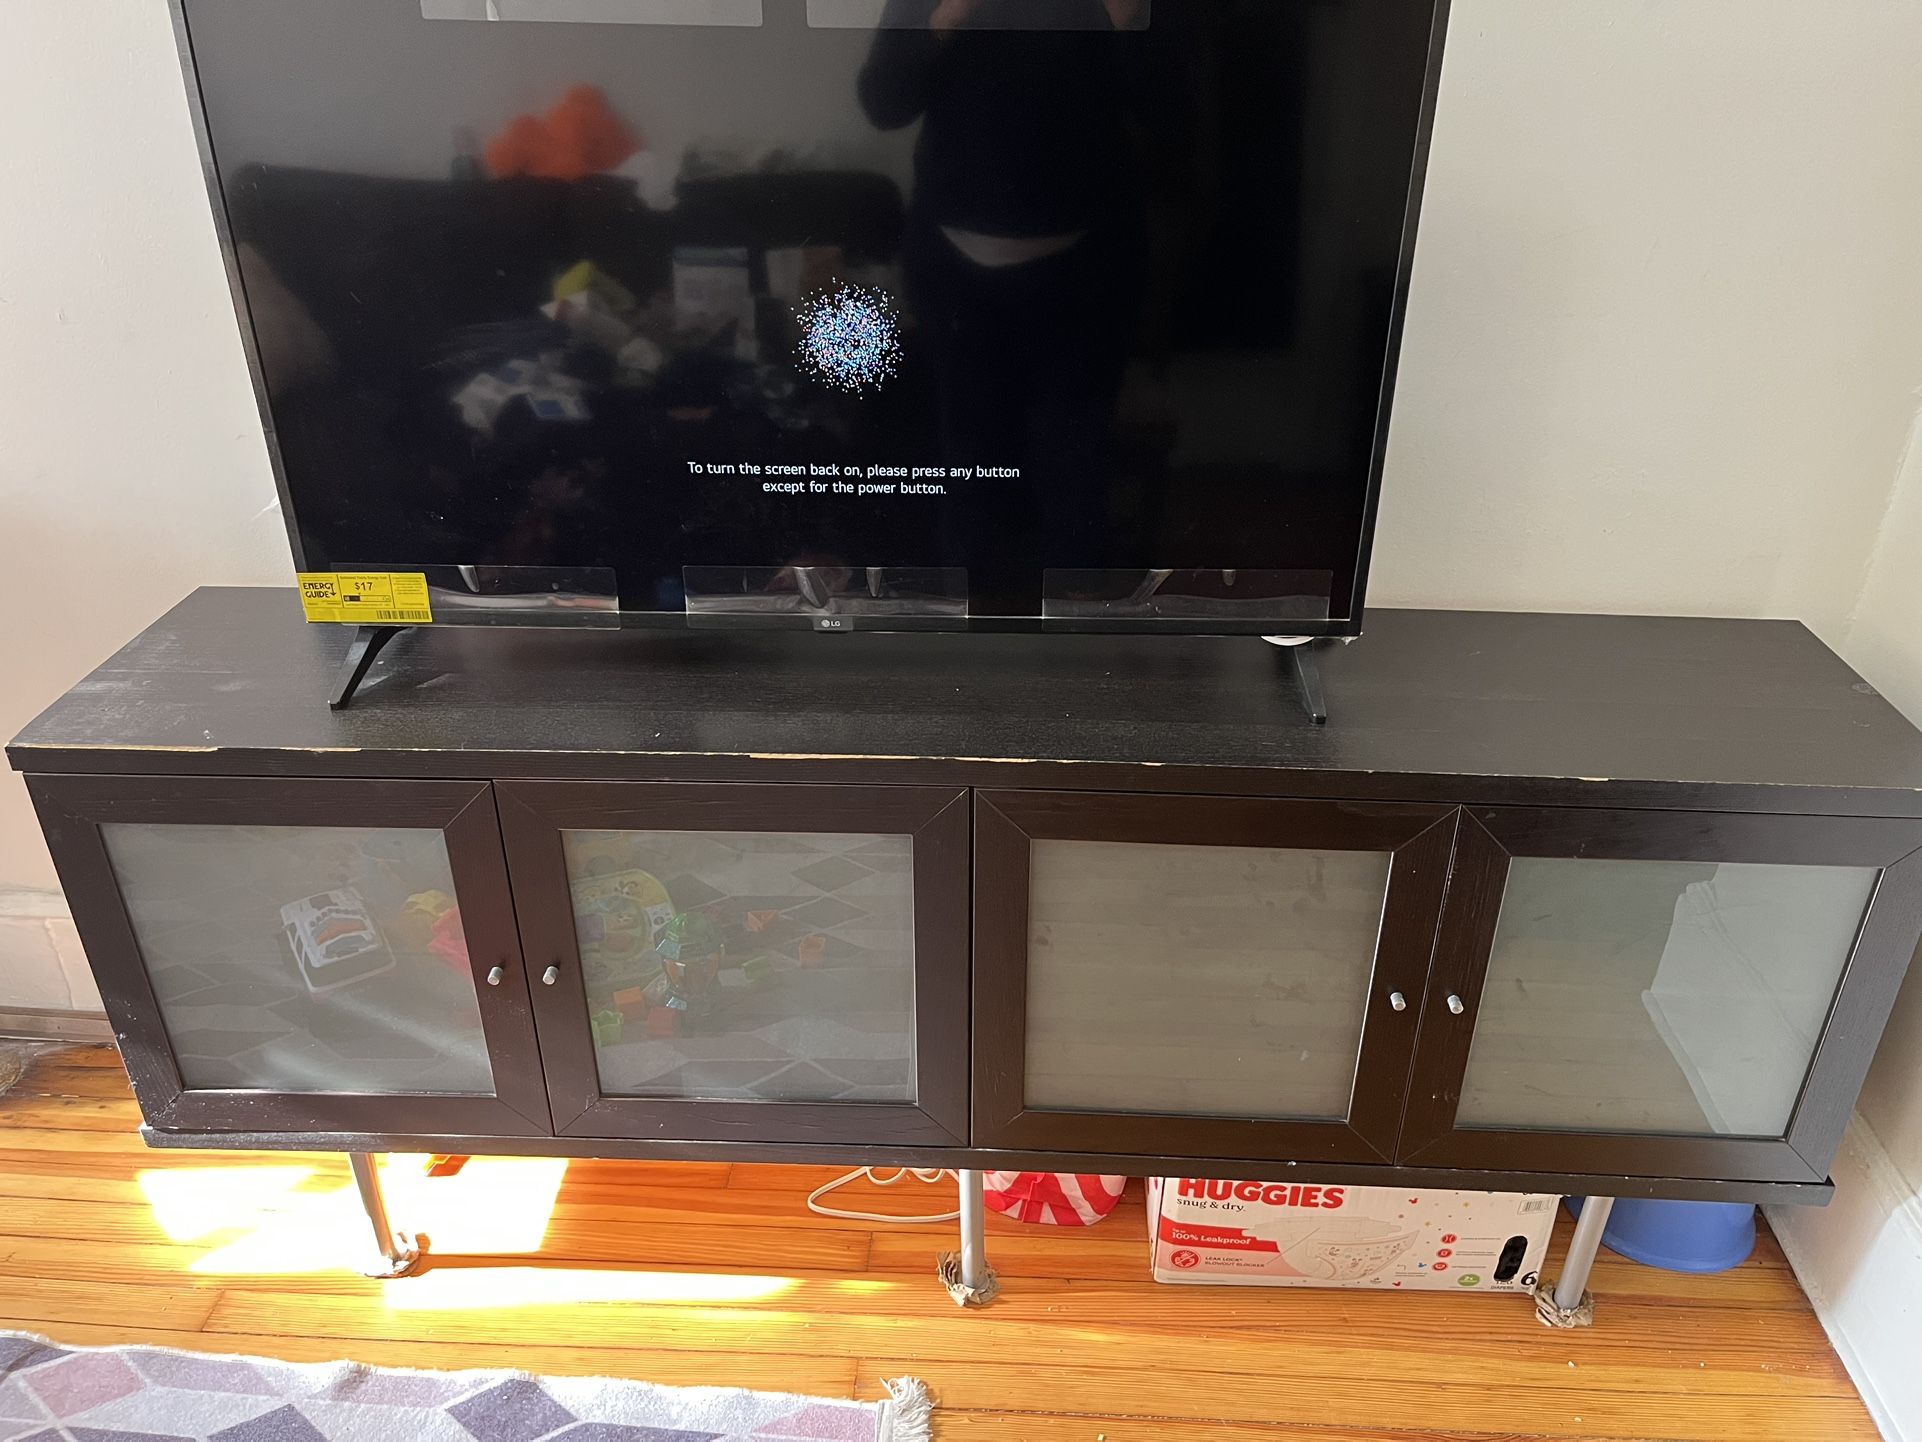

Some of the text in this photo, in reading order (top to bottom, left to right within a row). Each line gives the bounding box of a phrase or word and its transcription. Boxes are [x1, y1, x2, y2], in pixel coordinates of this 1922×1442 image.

[687, 462, 1020, 480] To turn the screen back on, please press any button
[762, 481, 947, 496] except for the power button.
[303, 582, 334, 591] ENERGY
[354, 582, 373, 591] $17
[305, 591, 330, 599] GUIDE
[1178, 1178, 1345, 1209] HUGGIES
[1177, 1199, 1207, 1209] snug
[1209, 1201, 1219, 1209] &
[1172, 1231, 1251, 1245] 100% Leakproof
[1521, 1271, 1538, 1286] 6
